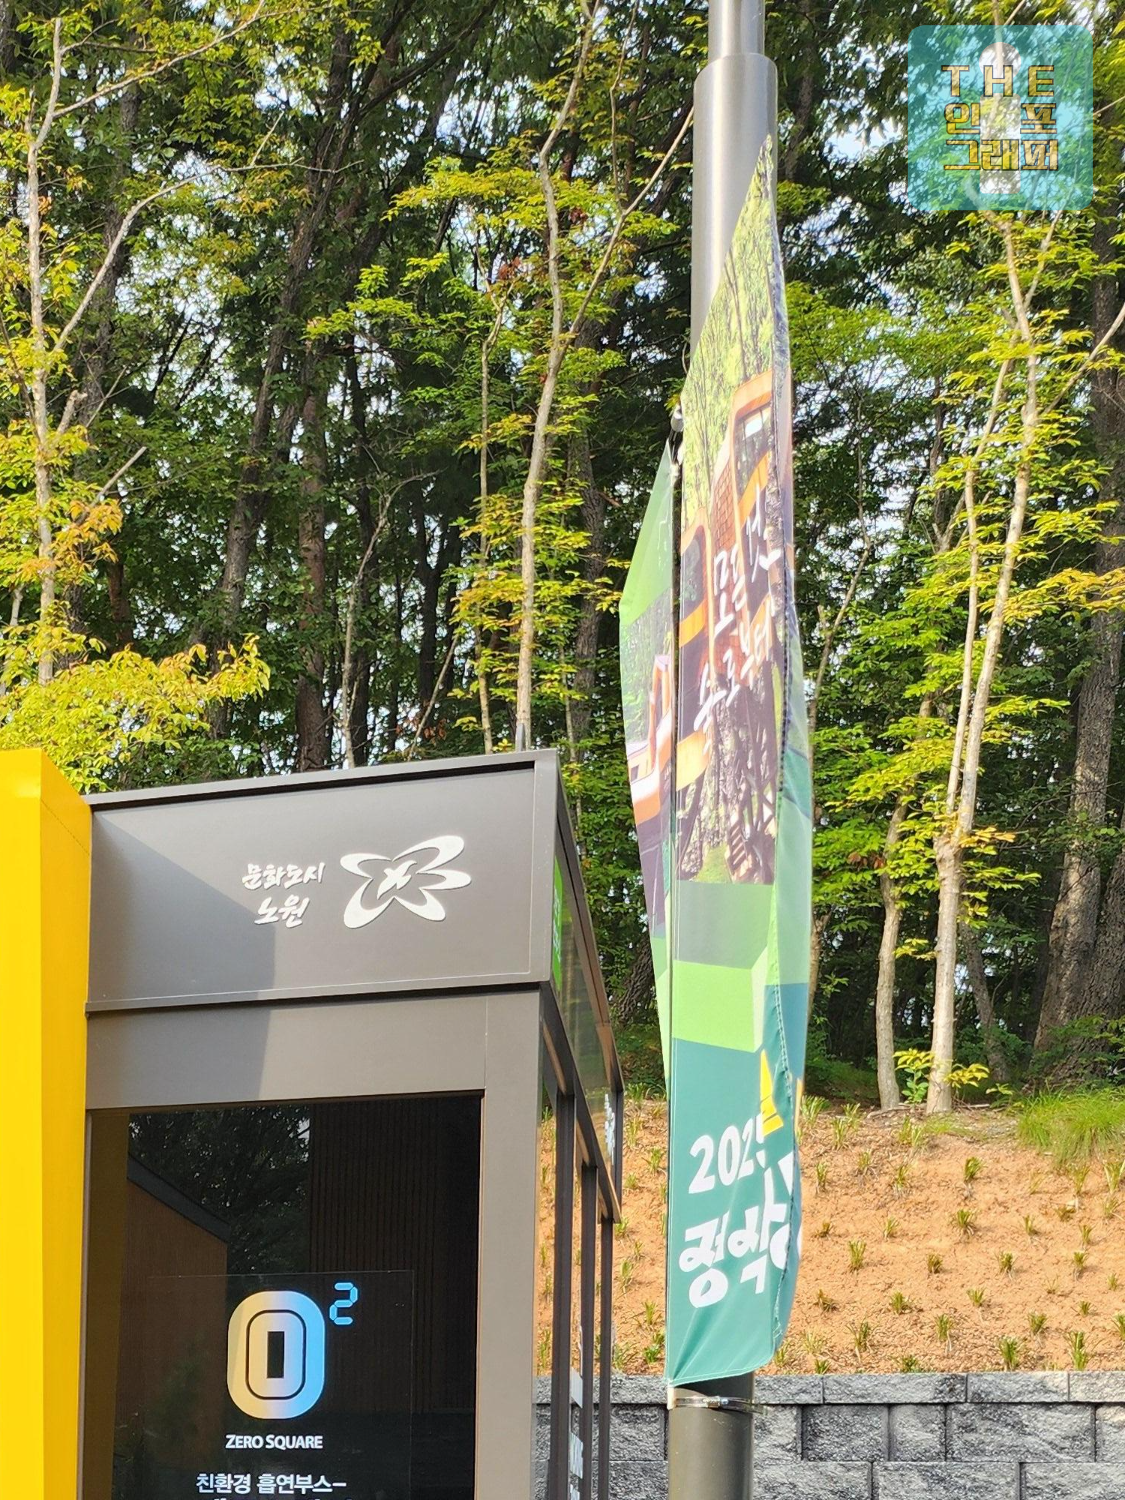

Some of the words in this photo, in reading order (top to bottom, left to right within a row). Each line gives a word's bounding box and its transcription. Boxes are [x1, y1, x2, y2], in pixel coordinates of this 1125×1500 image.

[242, 862, 325, 890] 문화도시
[254, 894, 310, 928] 노원
[225, 1434, 264, 1449] ZERO
[265, 1434, 323, 1450] SQUARE
[196, 1473, 251, 1494] 친환경
